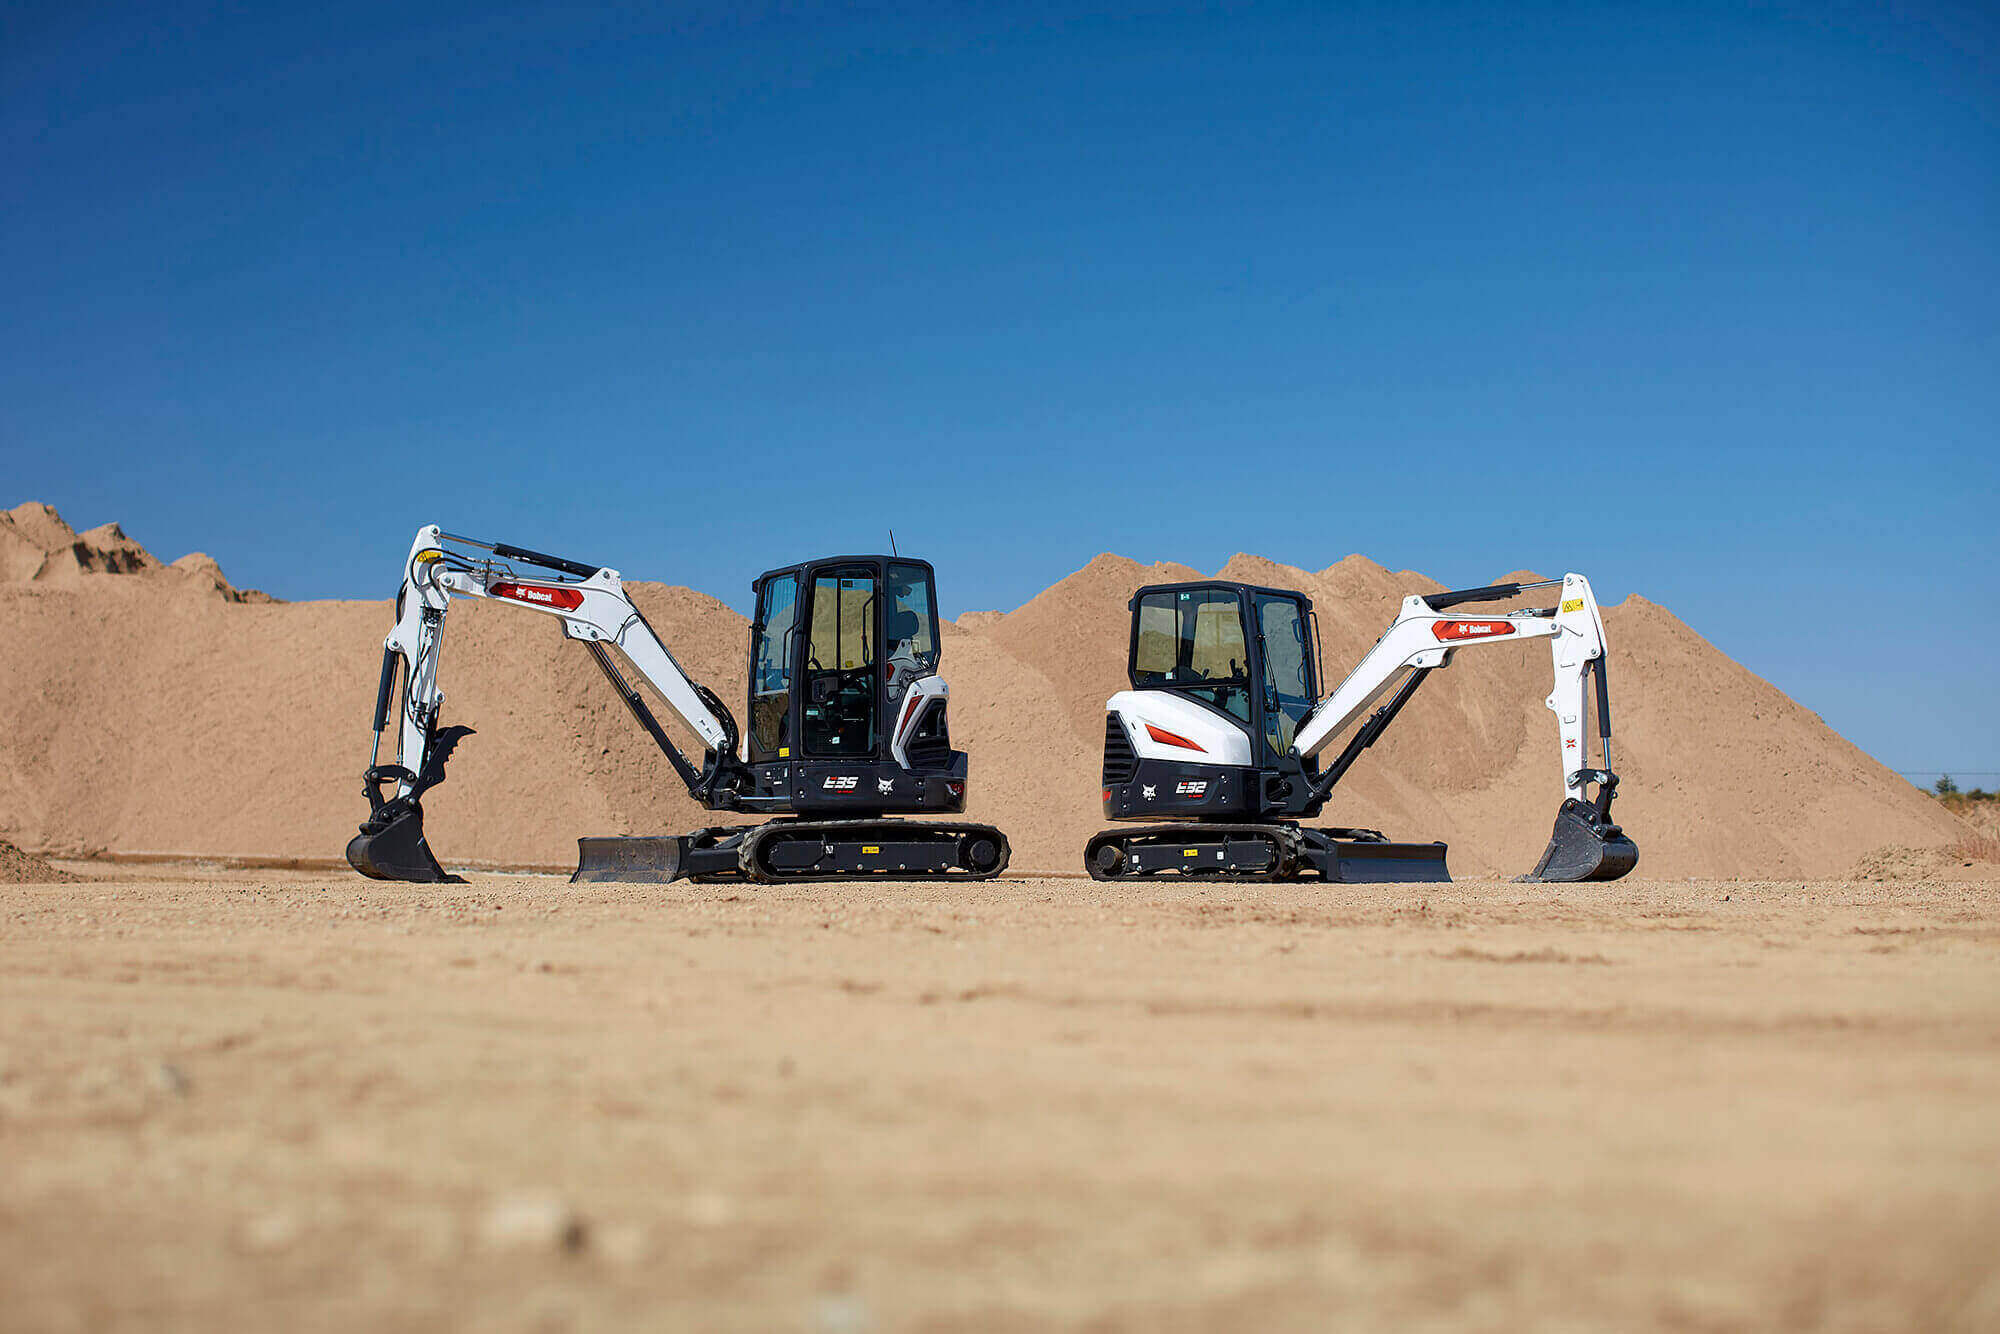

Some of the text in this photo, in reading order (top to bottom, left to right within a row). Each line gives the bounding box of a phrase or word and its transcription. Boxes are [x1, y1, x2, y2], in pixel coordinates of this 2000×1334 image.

[528, 591, 552, 602] Bobcat
[823, 776, 859, 789] E35
[1176, 781, 1208, 794] E32
